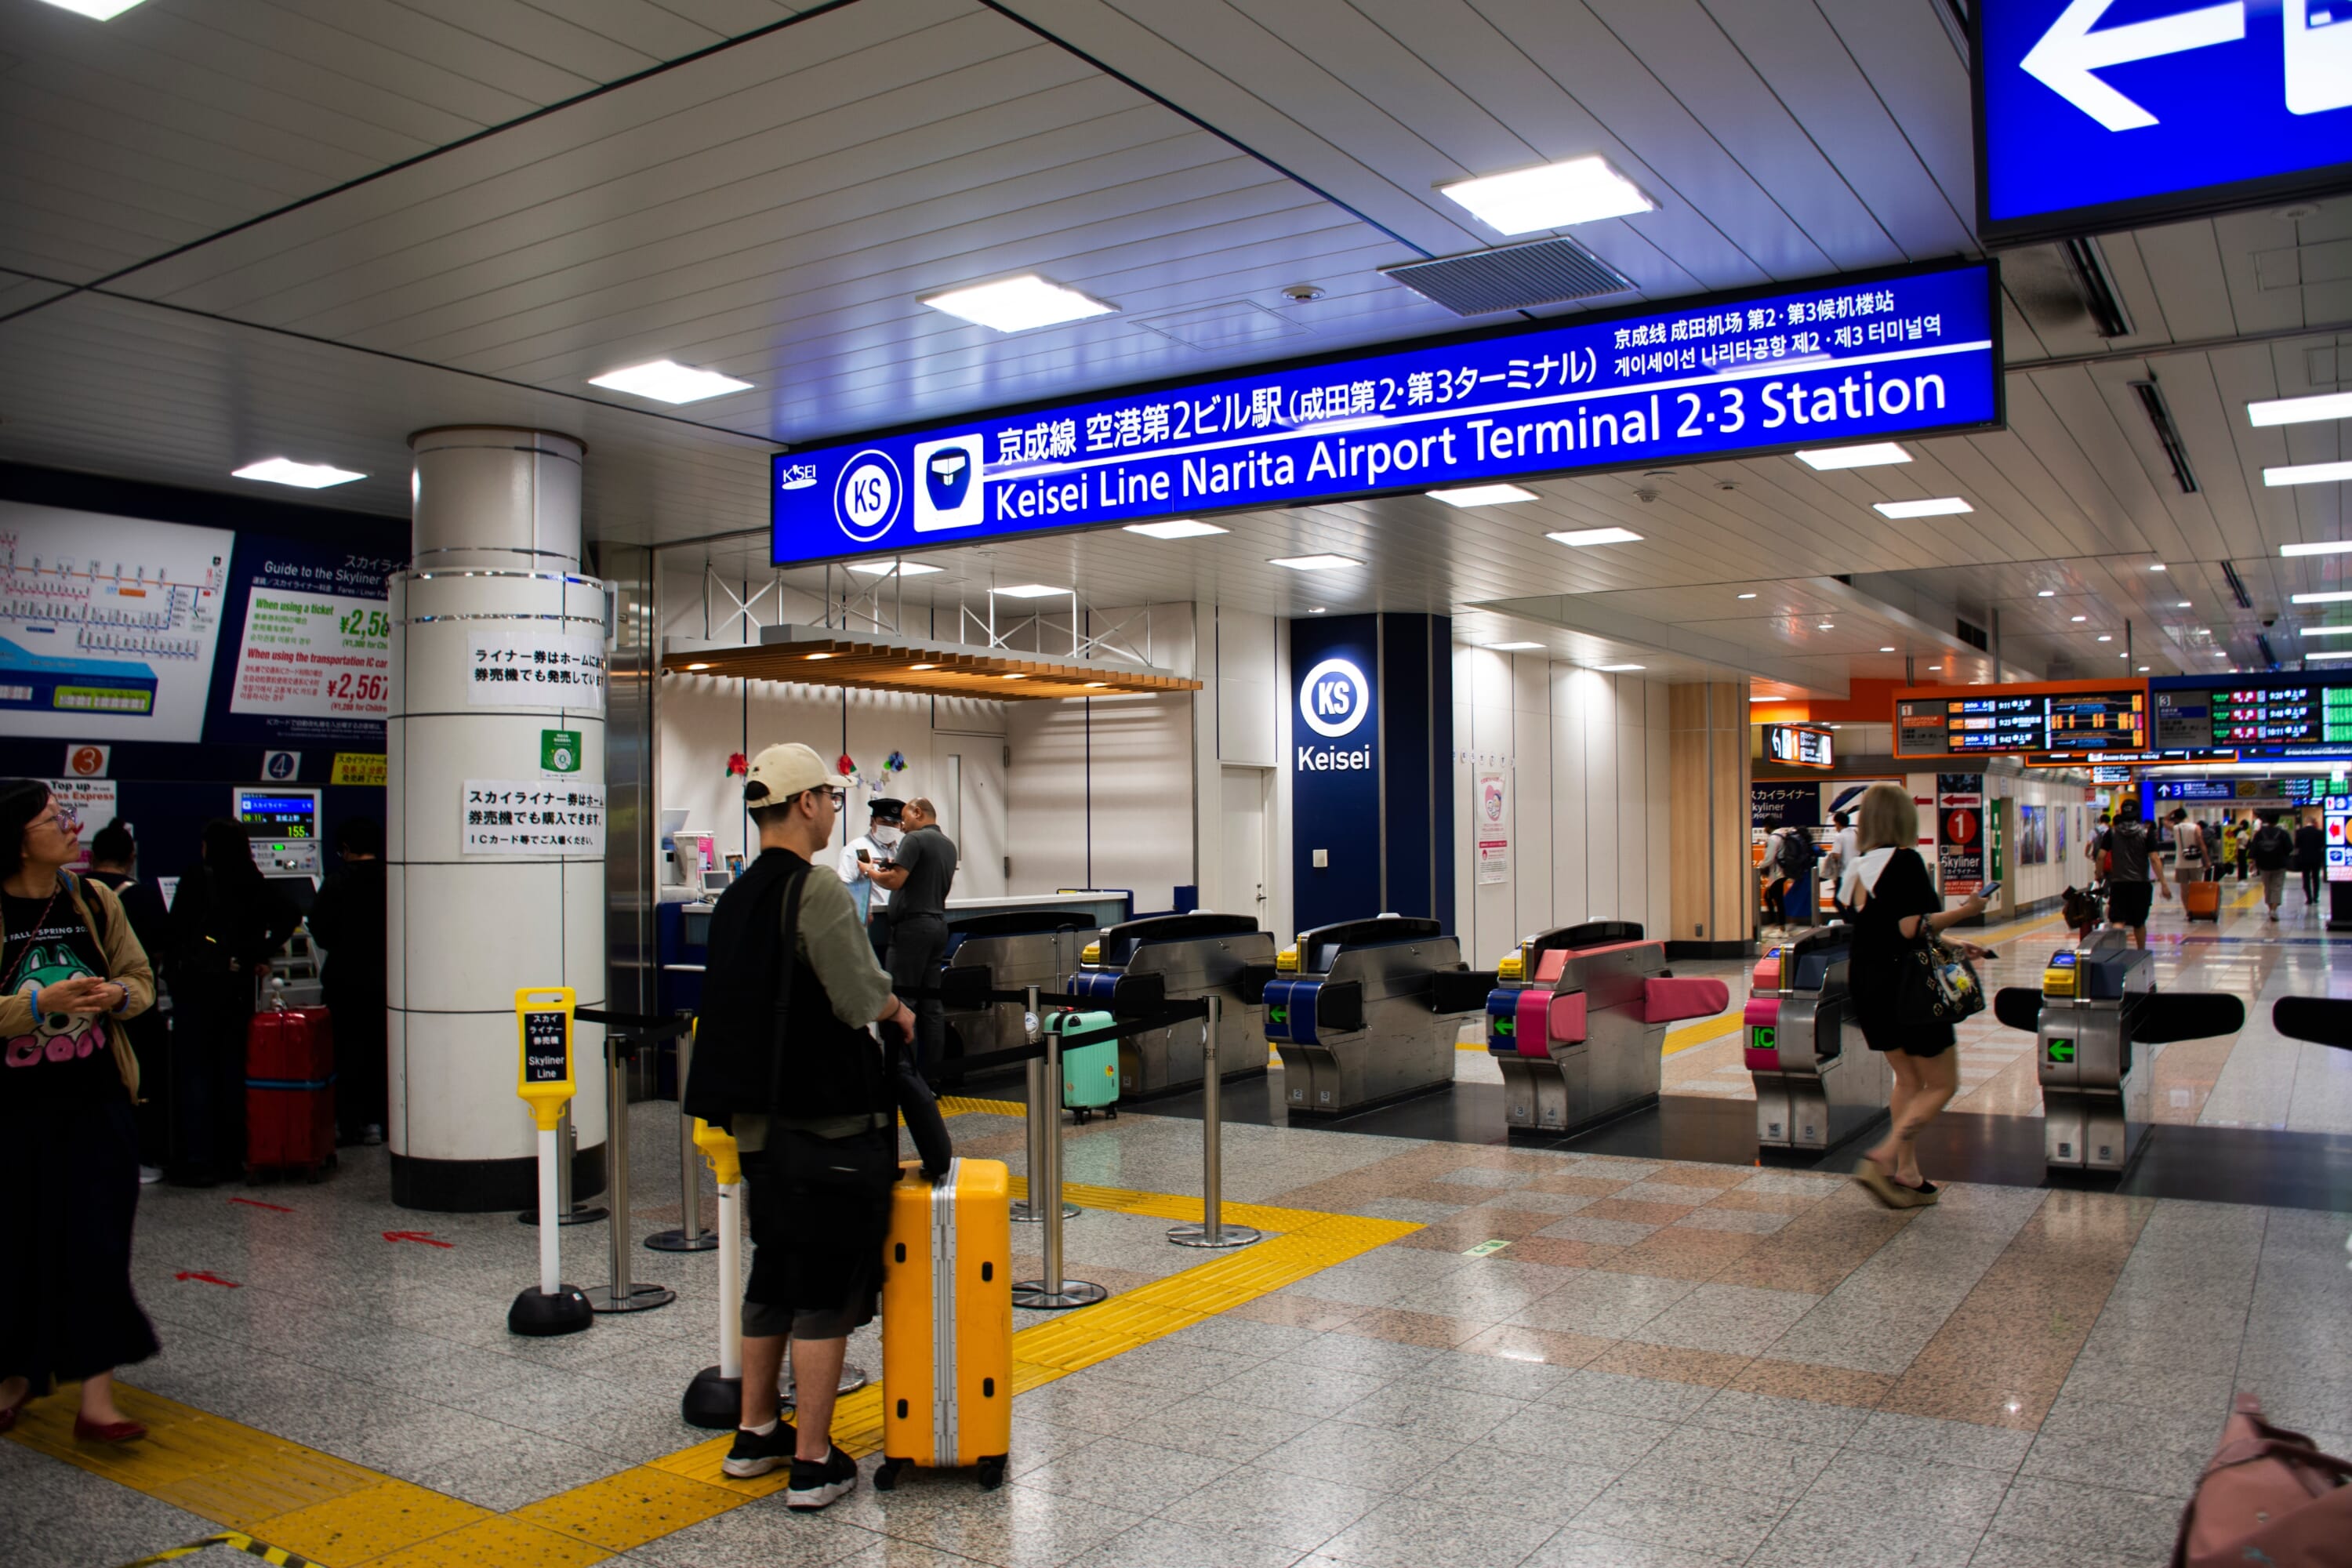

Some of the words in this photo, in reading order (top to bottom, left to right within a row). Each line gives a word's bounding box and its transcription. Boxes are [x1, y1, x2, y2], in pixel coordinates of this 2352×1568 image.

[1614, 321, 1667, 350] 京成线
[1671, 312, 1743, 343] 成田机场
[1613, 346, 1697, 377] 게이세이선
[1700, 335, 1788, 366] 나리타공항
[1868, 313, 1942, 344] 터미널역
[996, 472, 1088, 521] Keisei
[1100, 463, 1169, 509] Line
[1181, 448, 1295, 498] Narita
[1305, 426, 1457, 485] Airport
[1467, 394, 1660, 461] Terminal
[1762, 371, 1946, 428] Station
[997, 418, 1076, 466] 京成線
[854, 477, 881, 514] KS
[264, 561, 299, 576] Guide
[301, 567, 312, 578] to
[315, 566, 333, 580] the
[336, 568, 382, 586] Skyliner
[256, 597, 279, 611] When
[280, 600, 303, 614] using
[303, 604, 310, 612] a
[310, 603, 334, 616] ticket
[248, 648, 270, 660] When
[271, 650, 294, 664] using
[296, 651, 309, 663] the
[310, 652, 365, 668] transportation
[366, 657, 375, 666] IC
[326, 672, 388, 702] ¥2,567
[1318, 680, 1350, 716] KS
[1792, 734, 1798, 757] 1
[78, 749, 96, 773] 3
[272, 754, 287, 778] 4
[1298, 744, 1370, 771] Keisei
[52, 781, 73, 792] Top
[76, 782, 91, 792] up
[72, 793, 114, 803] Express
[2173, 786, 2182, 796] 3
[287, 826, 306, 838] 155
[1955, 813, 1964, 838] 1
[1941, 856, 1980, 869] Skyliner
[10, 930, 32, 942] FALL
[38, 926, 74, 937] SPRING
[529, 1025, 563, 1035] ライナー
[533, 1014, 558, 1024] スカイ
[533, 1036, 559, 1046] 券売機
[1752, 1026, 1775, 1049] IC
[528, 1055, 564, 1067] Skyliner
[537, 1069, 557, 1080] Line
